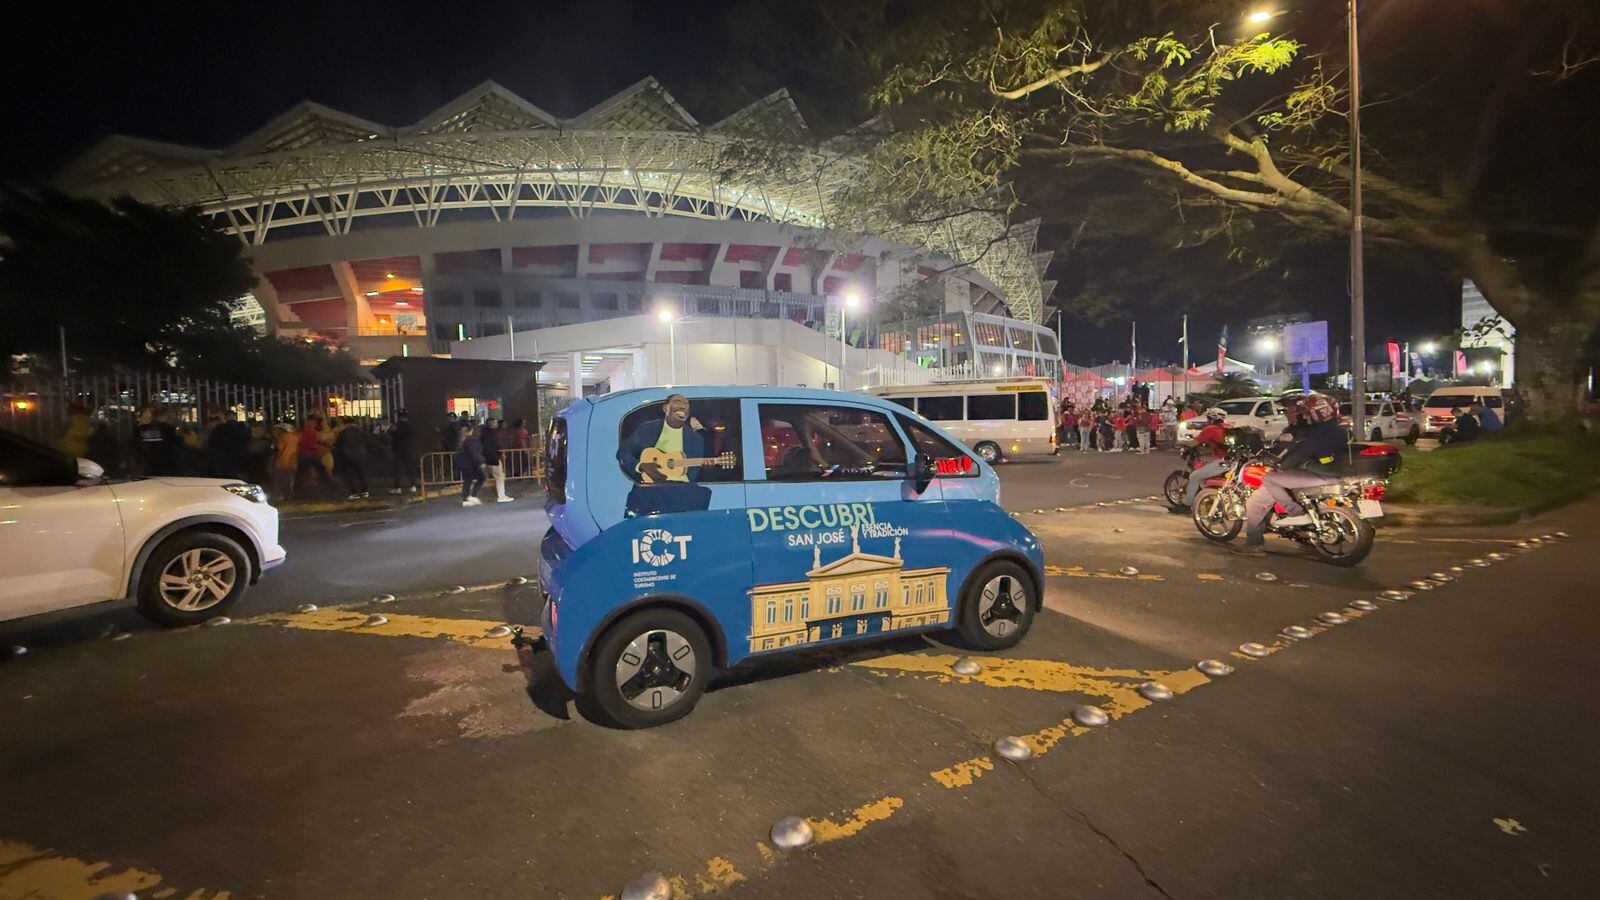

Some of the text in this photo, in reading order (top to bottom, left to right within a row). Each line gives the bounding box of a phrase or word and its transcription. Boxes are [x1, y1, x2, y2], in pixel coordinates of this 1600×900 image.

[861, 522, 892, 531] ESENCIA
[869, 526, 909, 538] TRADICIÓN
[788, 528, 845, 546] SAN JOSÉ
[632, 529, 692, 566] ICT
